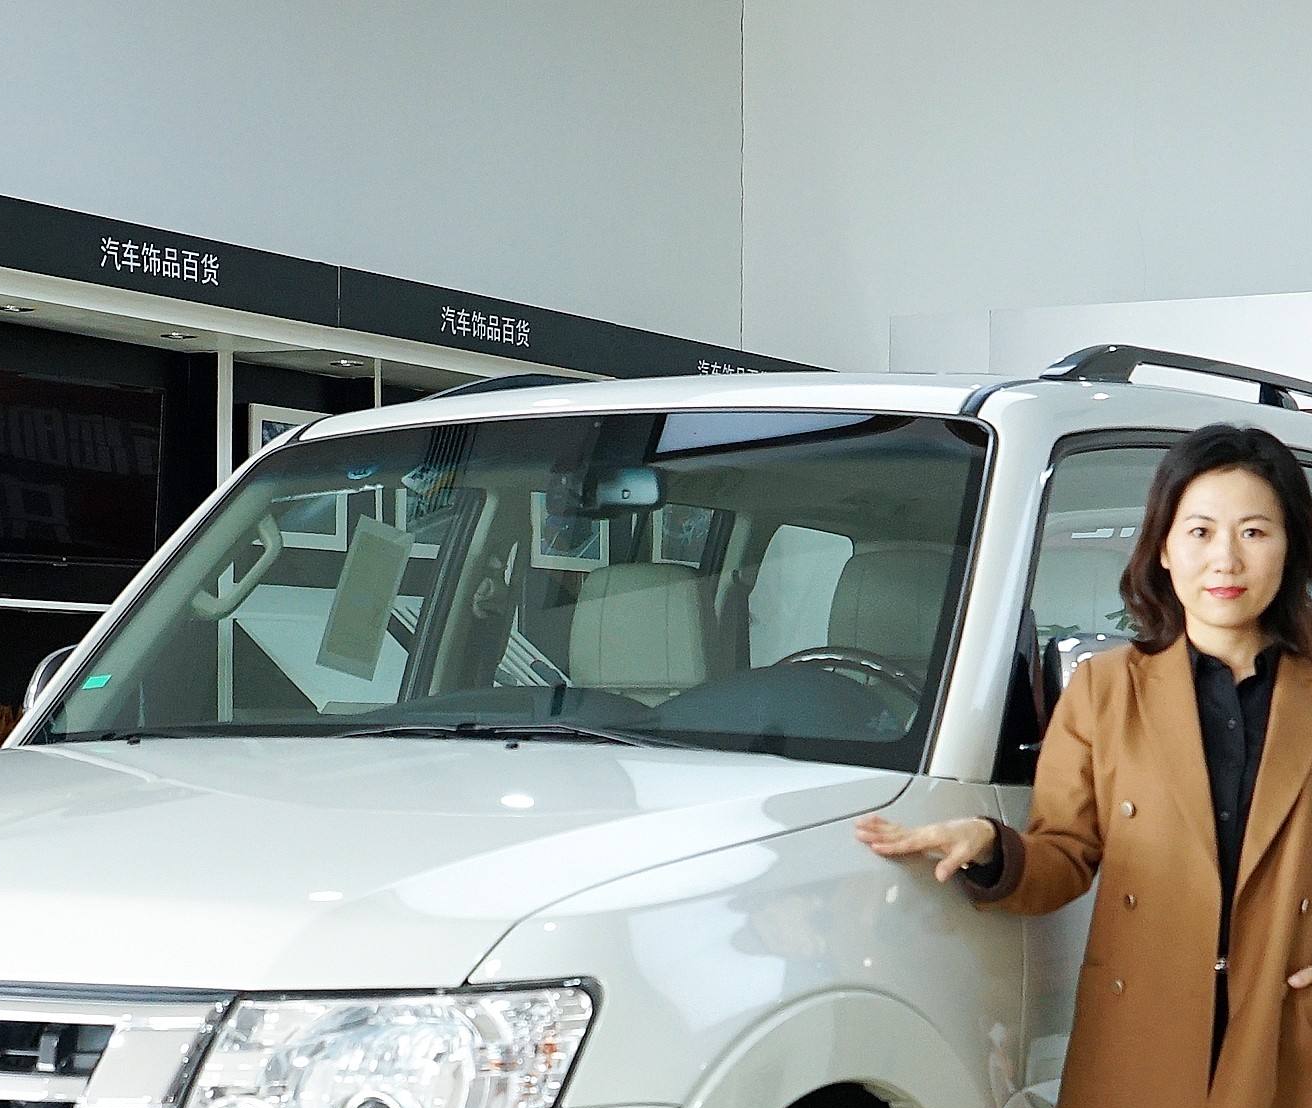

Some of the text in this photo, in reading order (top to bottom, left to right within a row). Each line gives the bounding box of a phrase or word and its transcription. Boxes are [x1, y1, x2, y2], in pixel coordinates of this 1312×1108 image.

[99, 236, 221, 287] 汽车饰品百货
[439, 305, 531, 349] 汽车饰品百货
